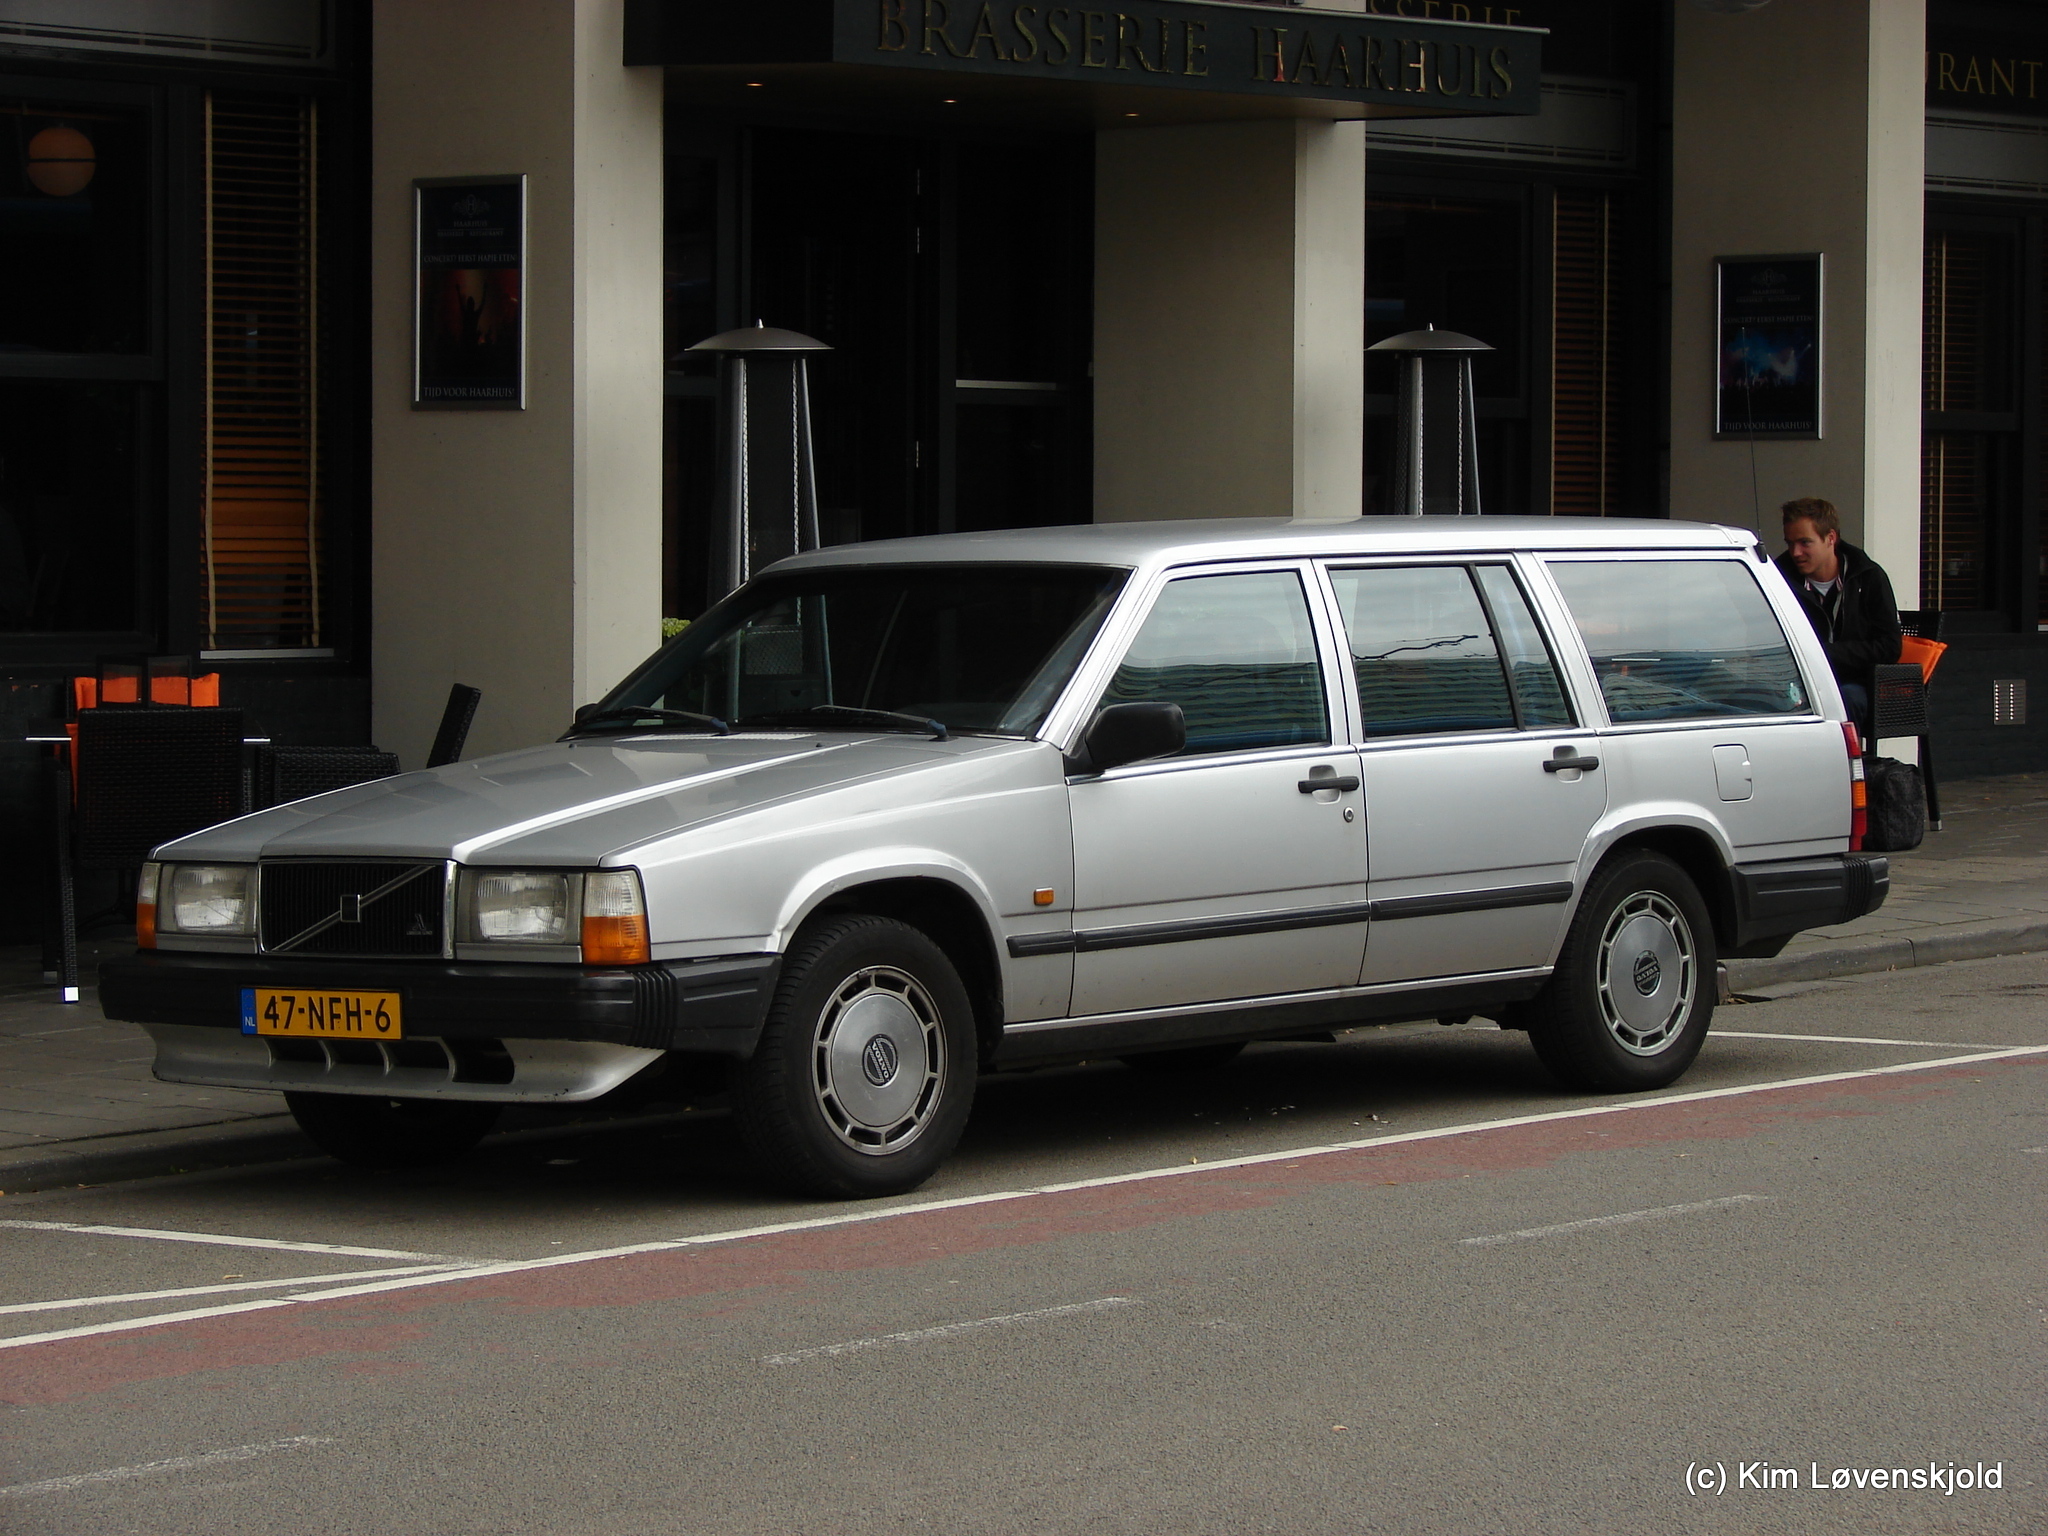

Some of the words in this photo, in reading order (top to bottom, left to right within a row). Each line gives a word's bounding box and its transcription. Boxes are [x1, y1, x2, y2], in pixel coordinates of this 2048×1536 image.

[876, 0, 1209, 77] BRASSERIE
[1251, 26, 1512, 99] HAARHUIS
[1926, 51, 2044, 99] RANT
[424, 386, 442, 398] TIJD
[443, 387, 468, 397] VOOR
[1724, 422, 1742, 431] TIJD
[1743, 421, 1767, 430] VOOR
[244, 1016, 256, 1027] NL
[264, 995, 391, 1033] 47-NFH-6
[872, 1040, 889, 1078] VOLVO
